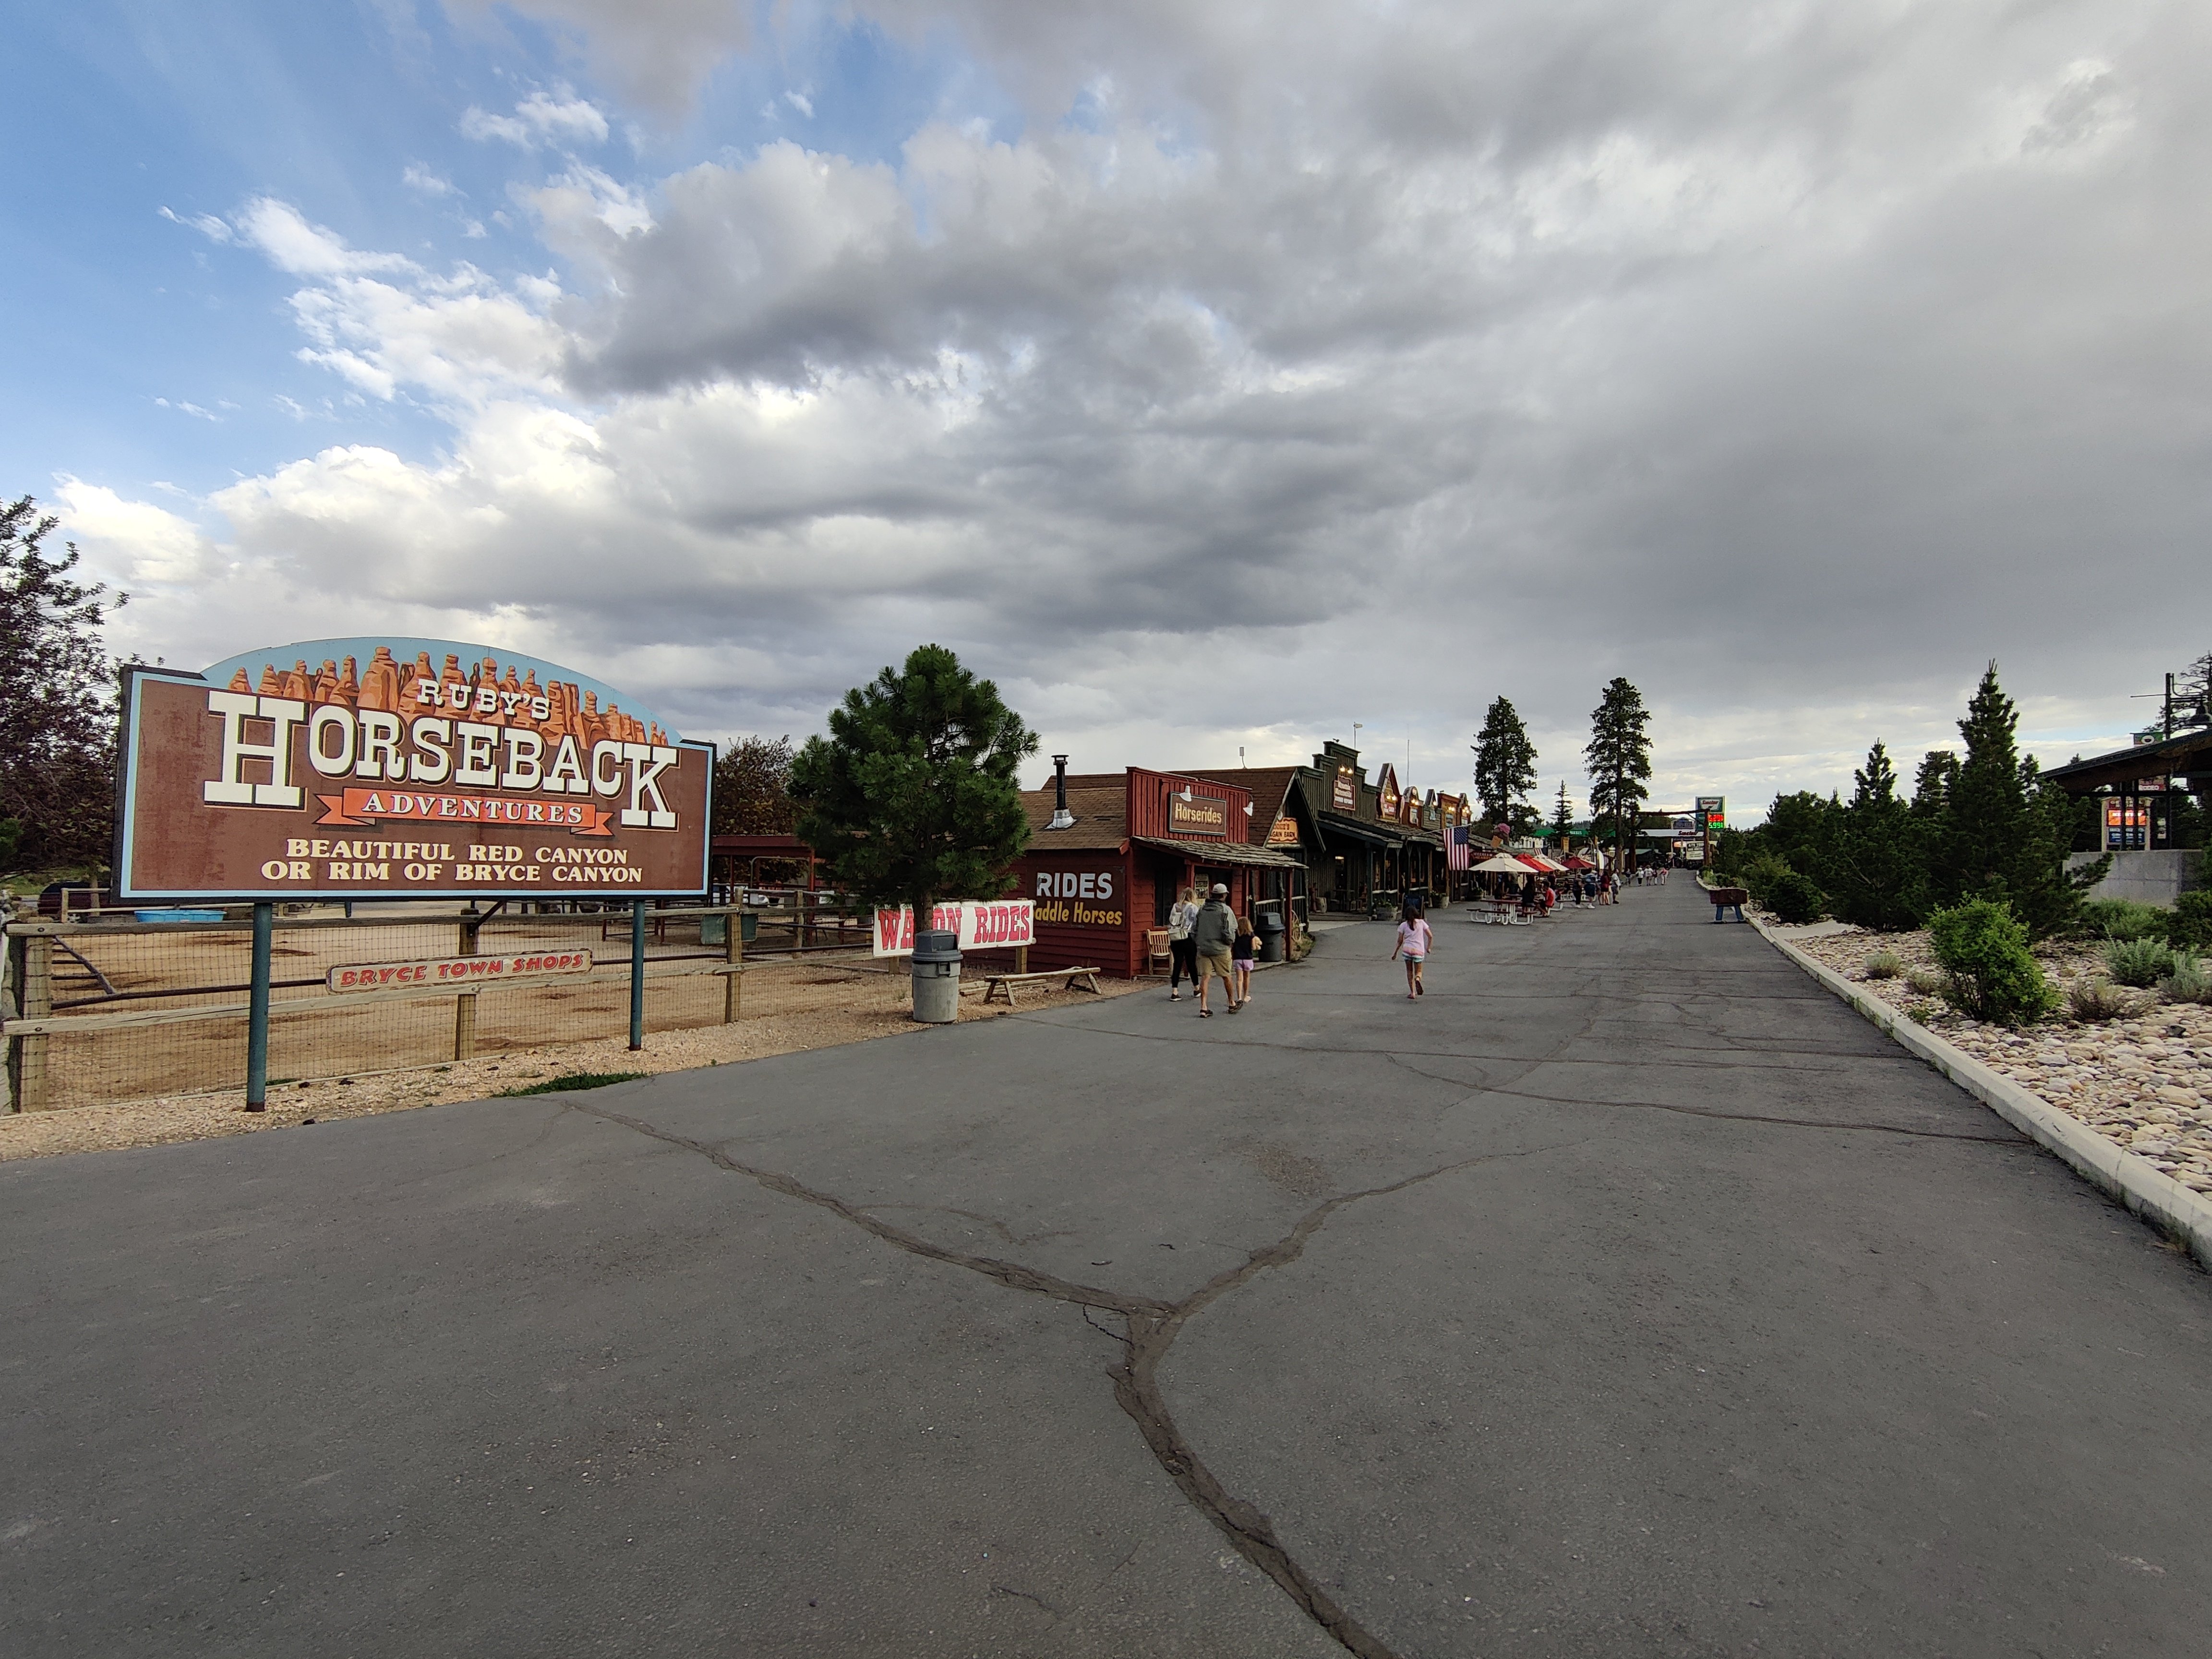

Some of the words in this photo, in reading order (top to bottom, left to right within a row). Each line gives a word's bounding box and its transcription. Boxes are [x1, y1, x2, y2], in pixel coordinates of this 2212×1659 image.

[417, 679, 551, 720] RUBY'S
[204, 690, 678, 829] HORSEBACK
[361, 792, 583, 823] ADVENTURES
[1175, 803, 1222, 825] Horserides
[286, 839, 455, 860] BEAUTIFUL
[469, 844, 523, 862] RED
[535, 847, 628, 864] CANYON
[261, 860, 311, 880] OR
[328, 862, 390, 880] RIM
[404, 863, 443, 880] OF
[455, 864, 541, 881] BRYCE
[552, 866, 642, 883] CANYON
[1036, 872, 1113, 900] RIDES
[878, 907, 962, 950] WAON
[974, 905, 1030, 944] RIDES
[1034, 900, 1070, 922] addle
[1073, 902, 1123, 926] Horses
[340, 965, 428, 987] BRYCE
[438, 960, 504, 978] TOWN
[512, 954, 584, 972] SHOPS
